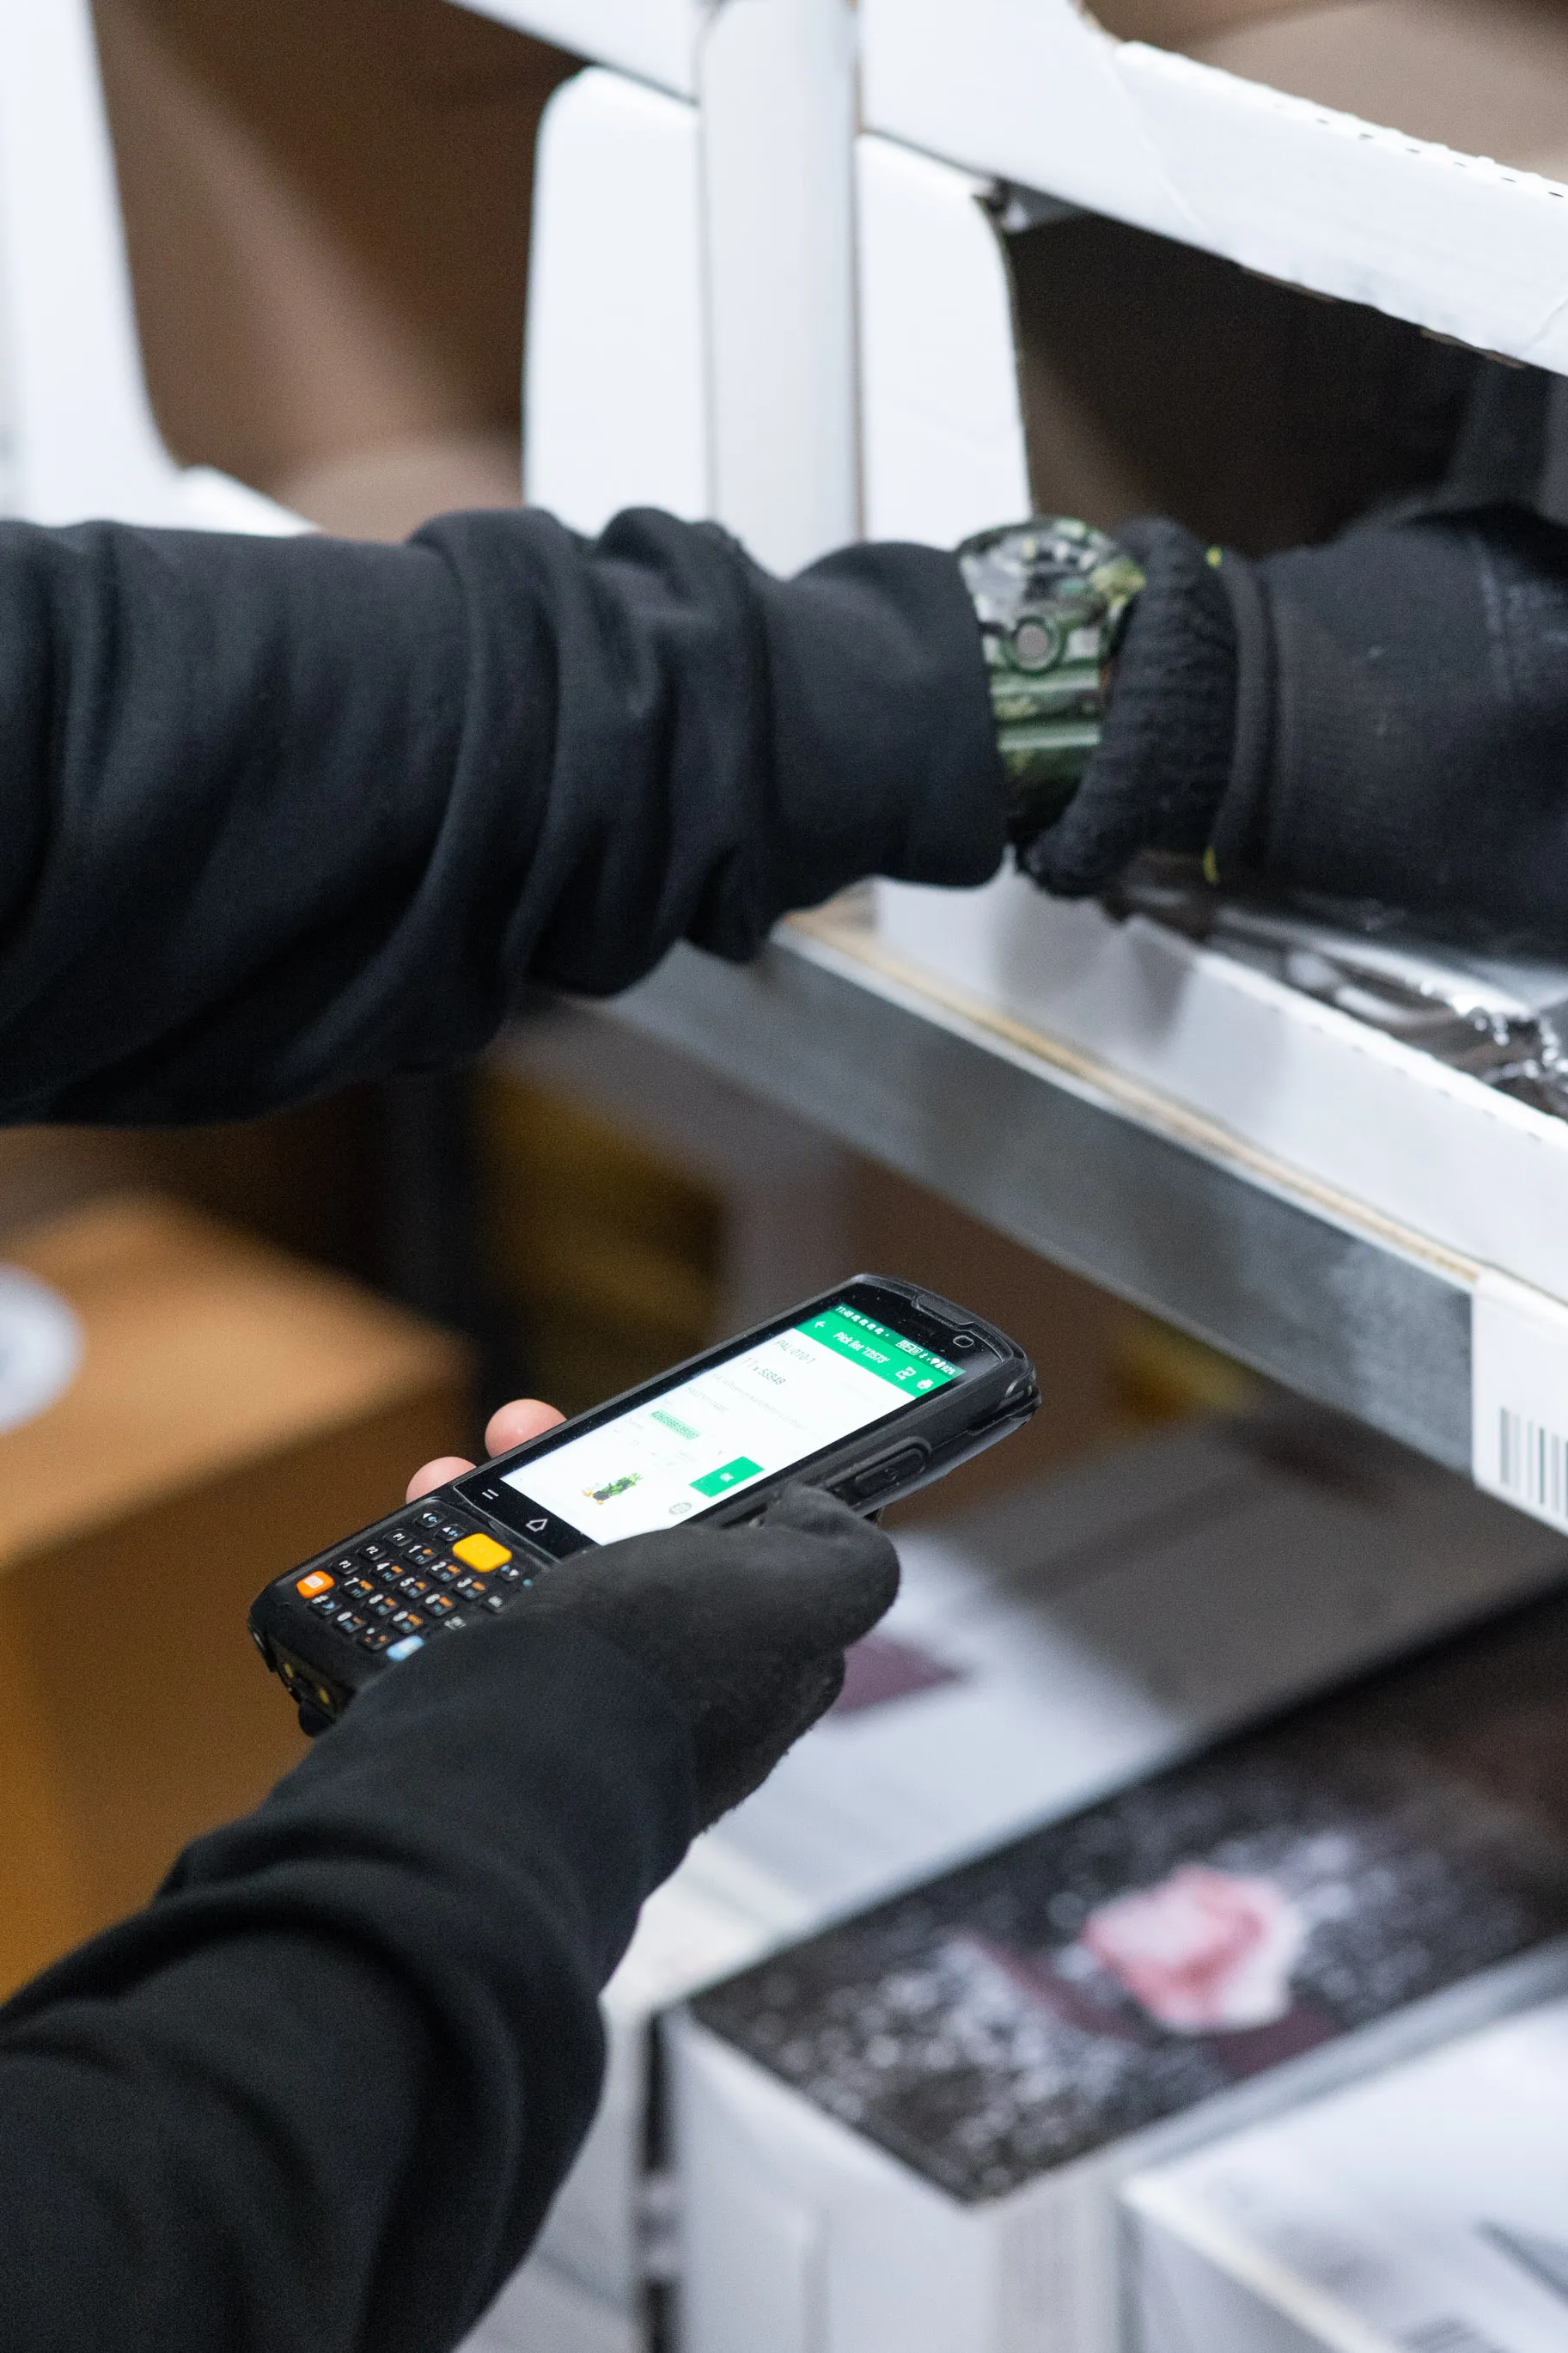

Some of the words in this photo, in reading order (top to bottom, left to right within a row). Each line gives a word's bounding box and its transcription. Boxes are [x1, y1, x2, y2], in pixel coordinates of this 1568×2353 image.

[833, 1331, 853, 1346] Pick
[848, 1341, 864, 1352] list
[366, 1546, 379, 1555] P2
[408, 1545, 422, 1554] 1
[339, 1560, 351, 1568] P3
[376, 1562, 391, 1571] 4
[430, 1561, 447, 1571] 2
[344, 1577, 359, 1586] 7
[400, 1577, 416, 1587] 5
[457, 1578, 473, 1588] 3
